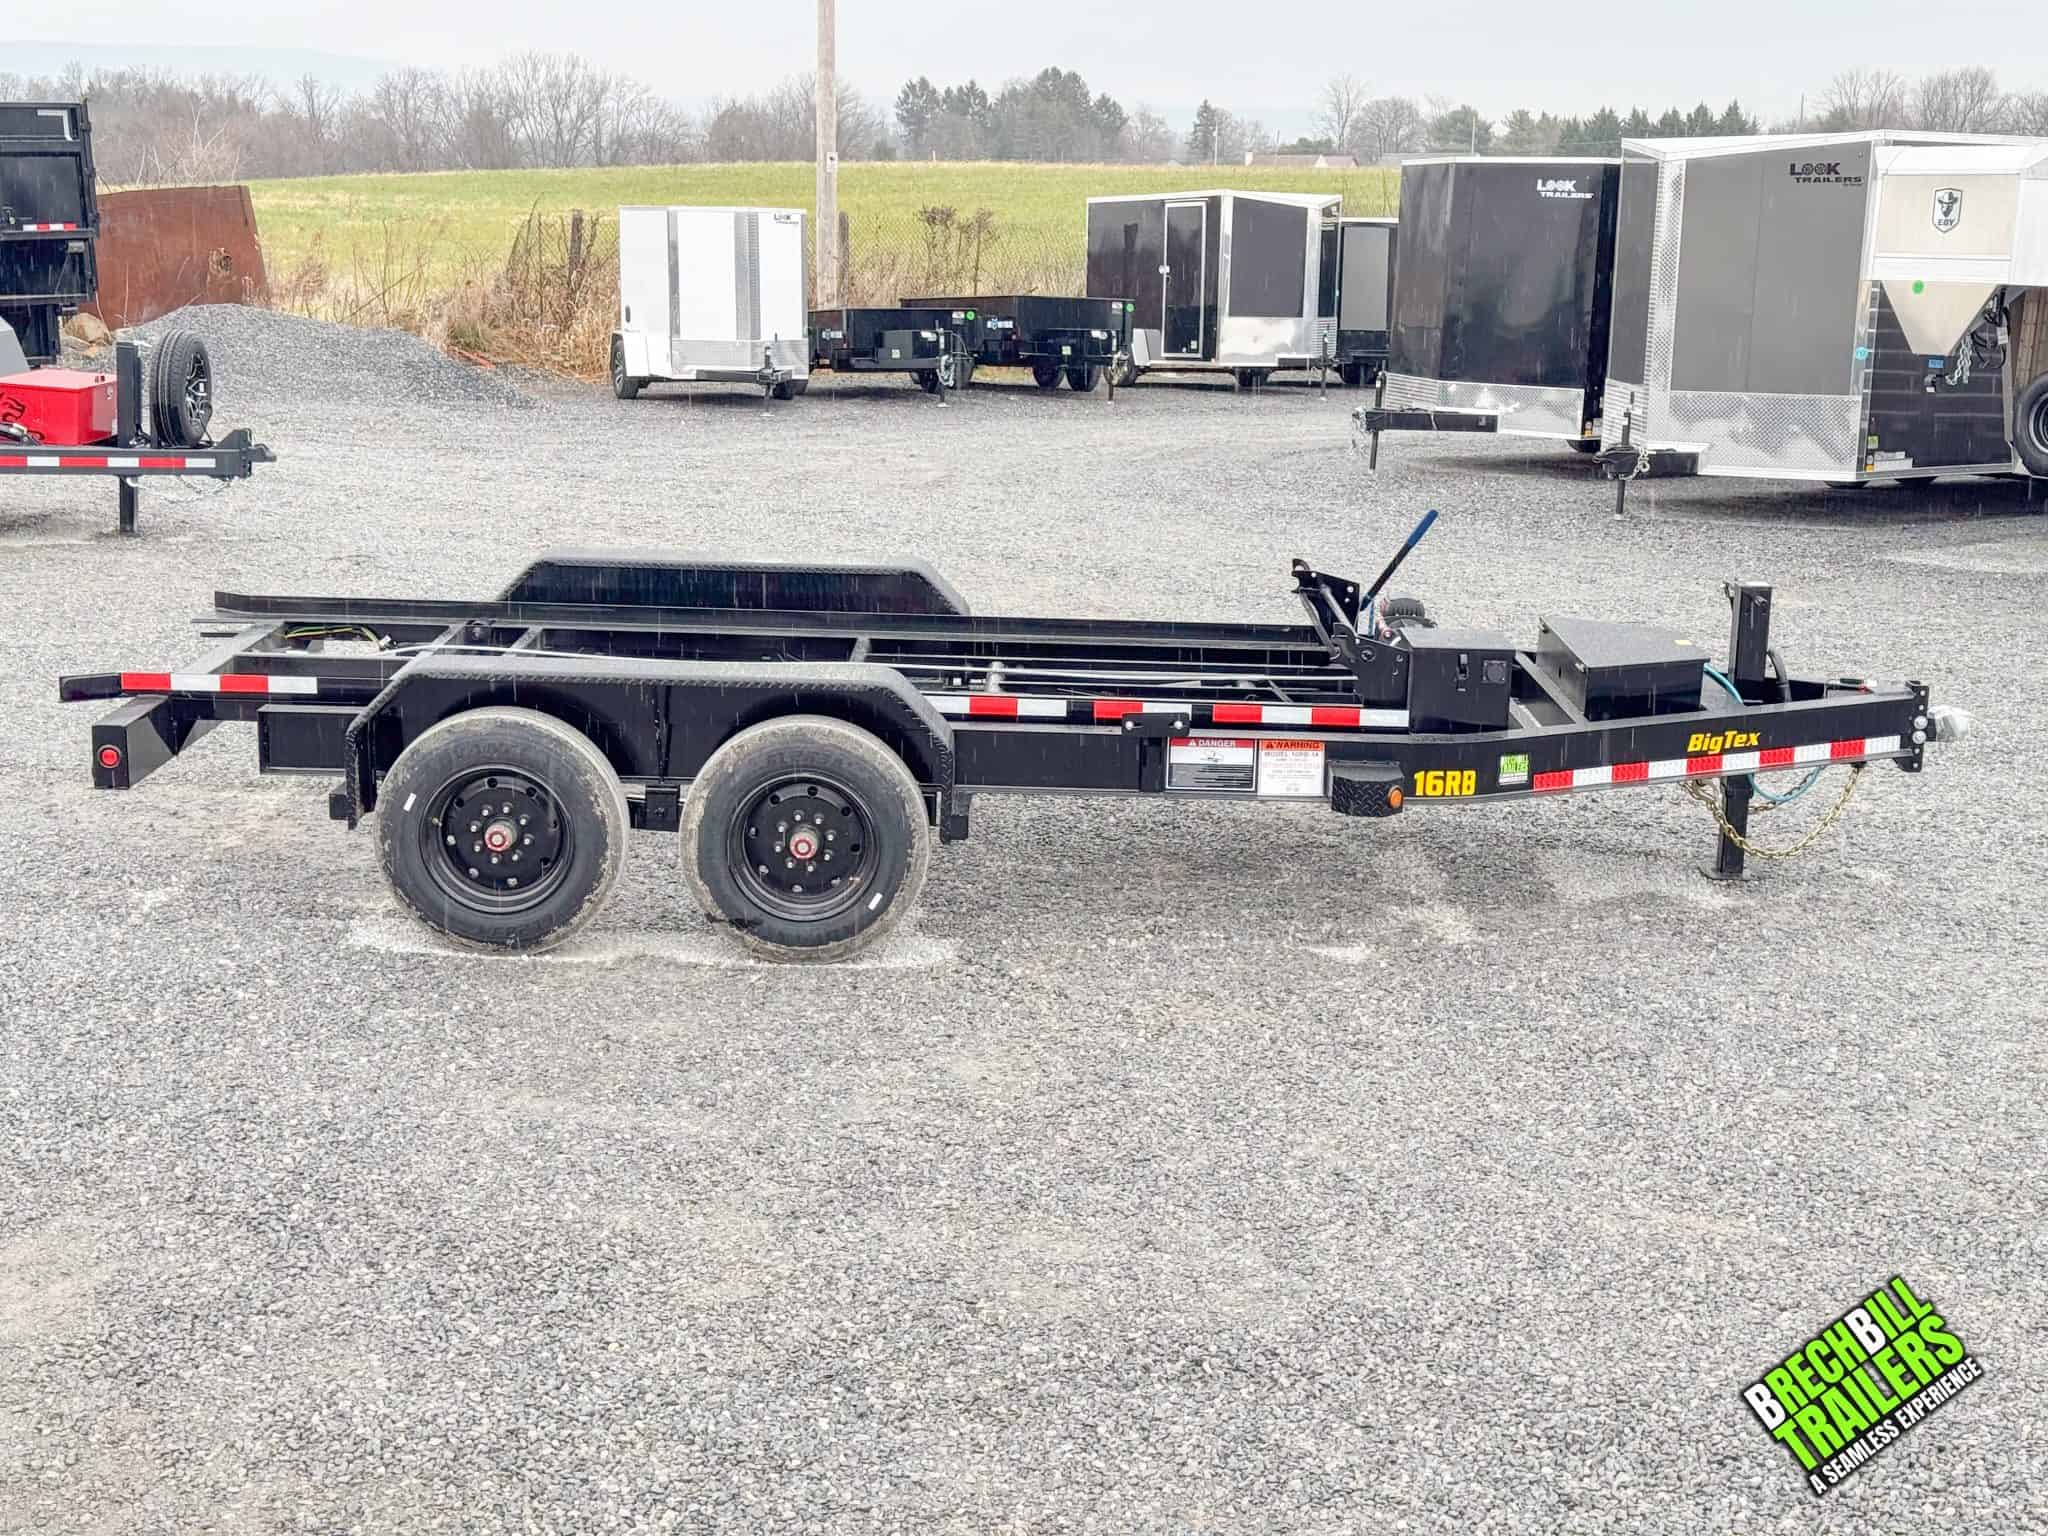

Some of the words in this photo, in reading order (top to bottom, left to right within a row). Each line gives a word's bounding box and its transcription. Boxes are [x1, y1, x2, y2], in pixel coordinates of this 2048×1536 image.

[1790, 162, 1841, 176] LOOK
[1536, 178, 1577, 192] LOOK
[1795, 176, 1862, 184] TRAILERS
[1540, 191, 1594, 199] TRAILERS
[1198, 738, 1236, 748] DANGER
[1276, 741, 1320, 749] WARNING
[1687, 729, 1761, 755] BigTex
[1413, 769, 1477, 797] 16RB
